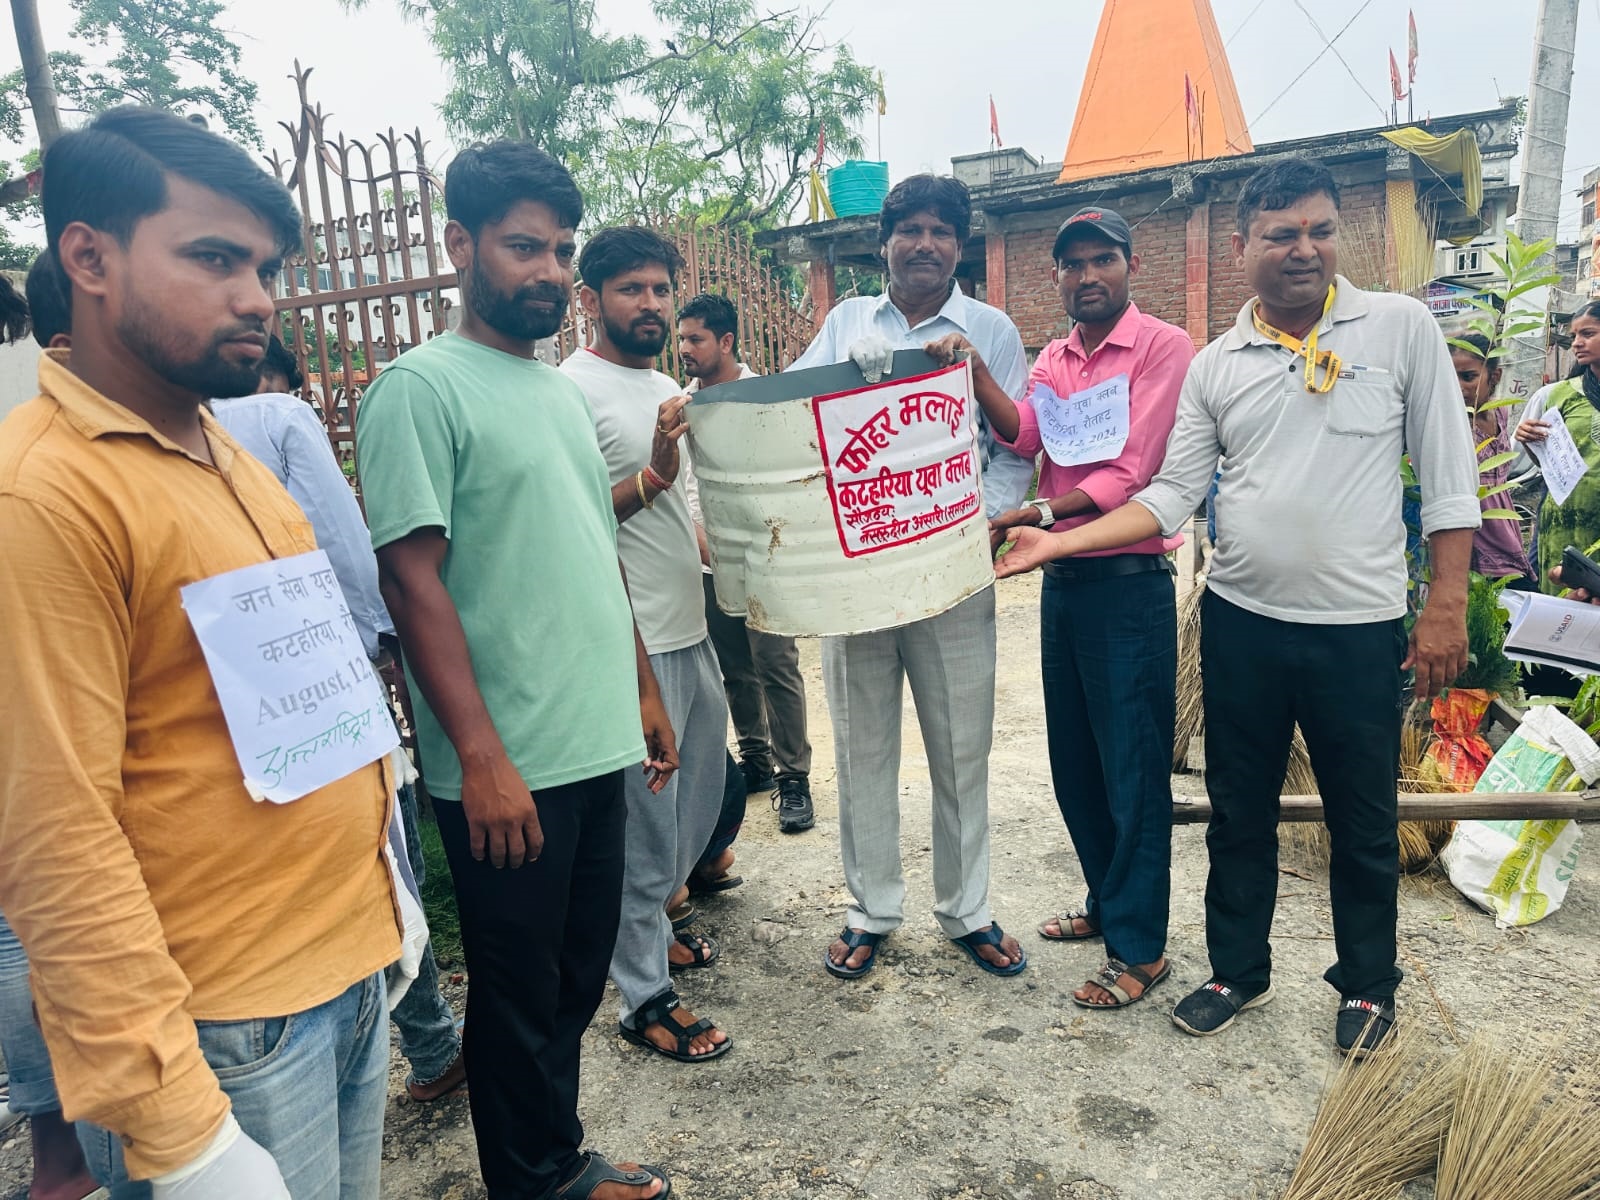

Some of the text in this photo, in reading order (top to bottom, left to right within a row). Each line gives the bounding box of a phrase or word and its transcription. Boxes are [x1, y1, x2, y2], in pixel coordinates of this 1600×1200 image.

[836, 391, 965, 474] फोहर मलाई
[1089, 426, 1117, 443] 2024
[838, 466, 914, 509] कटहरिया
[232, 585, 275, 614] जन
[278, 573, 309, 601] सेवा
[257, 618, 344, 664] कटहरिया,
[1555, 614, 1573, 635] USAID
[257, 671, 353, 727] August,
[1203, 983, 1232, 997] NINE
[1346, 999, 1381, 1014] NINE
